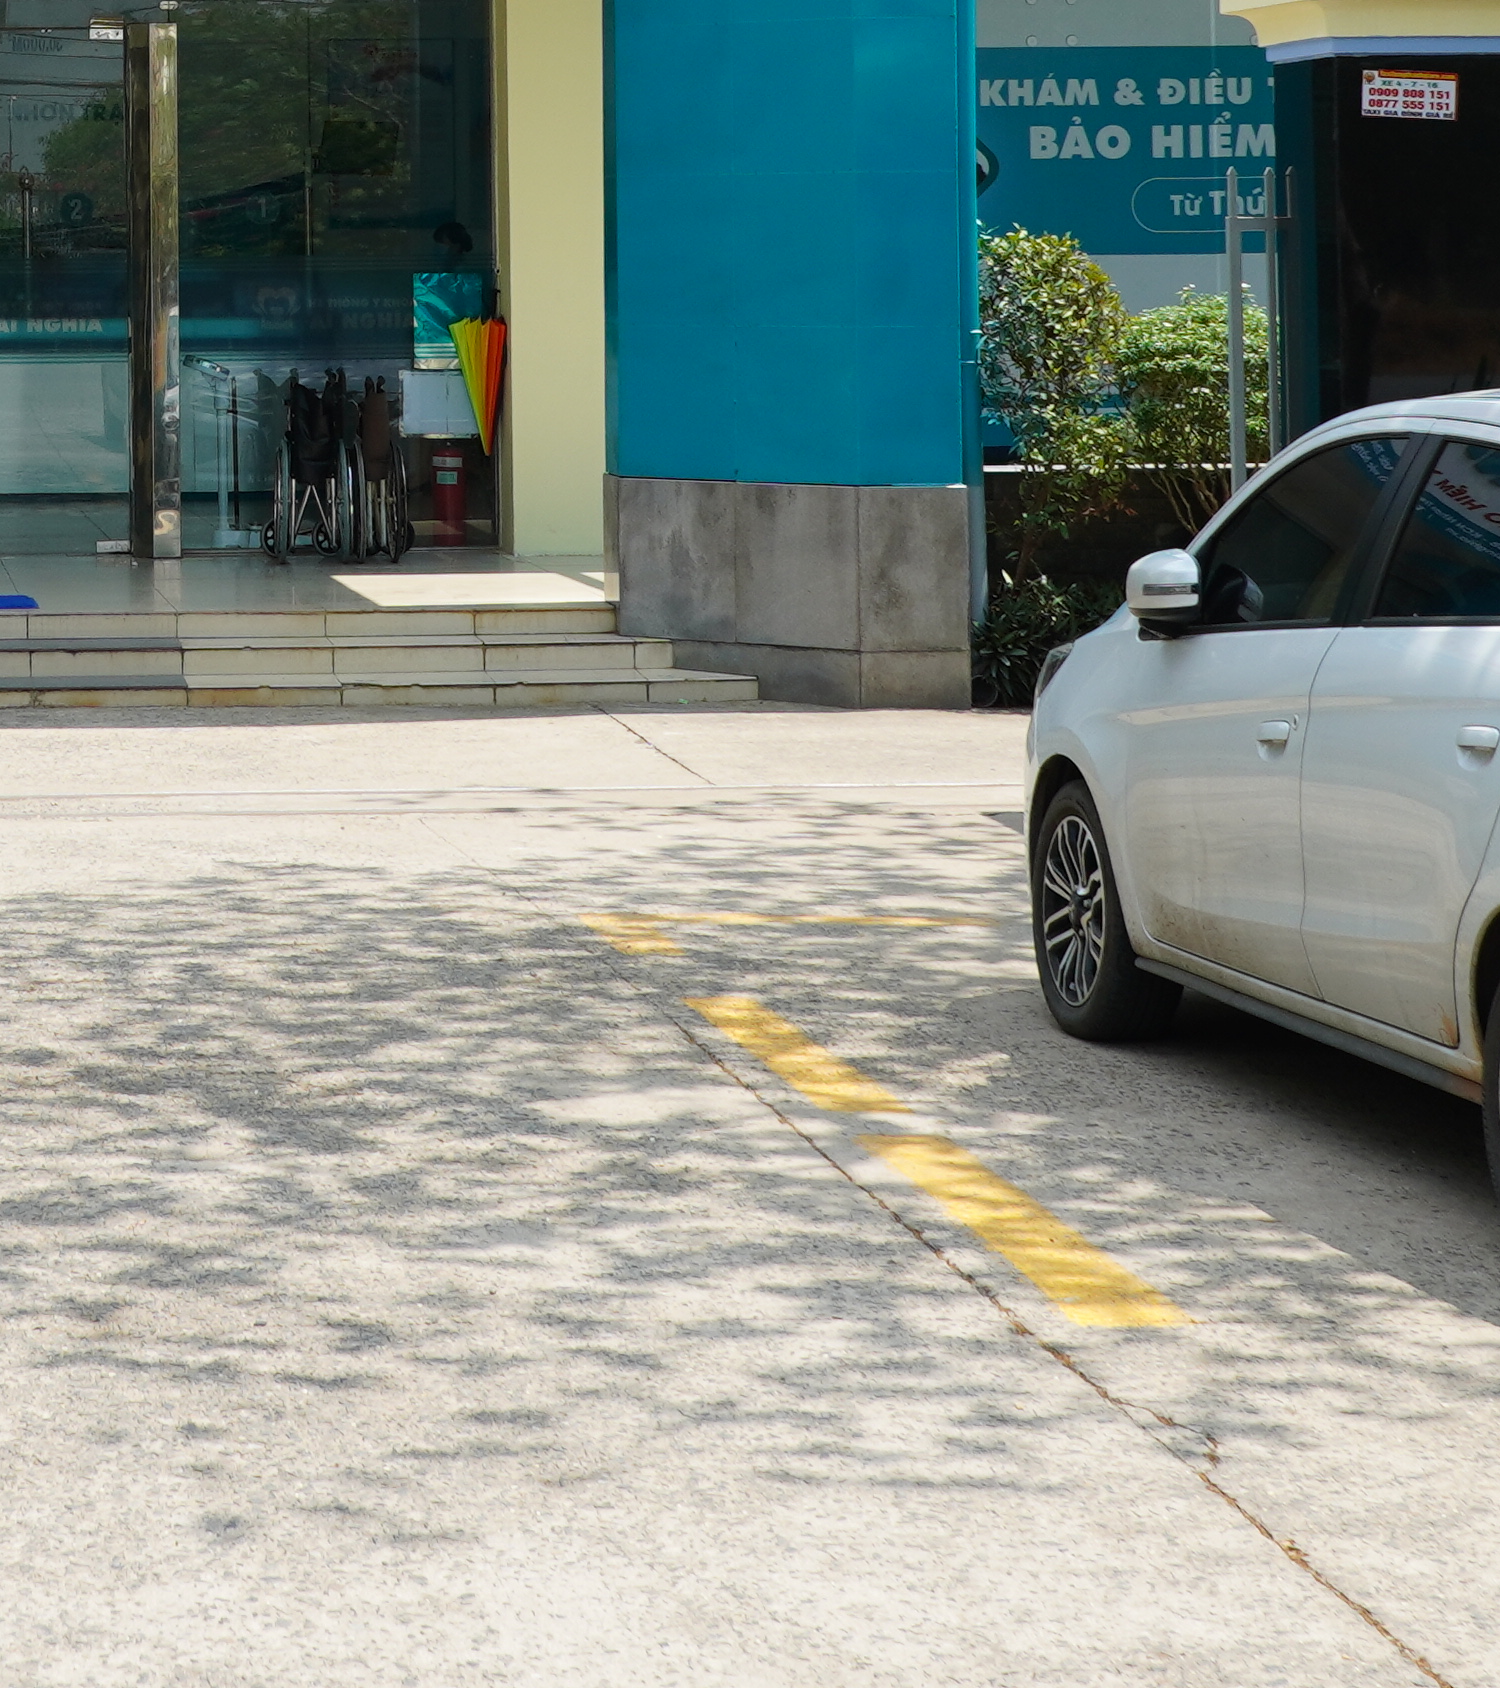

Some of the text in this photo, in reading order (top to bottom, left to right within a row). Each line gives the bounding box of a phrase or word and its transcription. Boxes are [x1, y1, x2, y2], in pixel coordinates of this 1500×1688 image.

[979, 73, 1100, 107] KHÁM
[1113, 78, 1146, 106] &
[1157, 68, 1252, 105] ĐIỀU
[1368, 88, 1399, 97] 0909
[1429, 91, 1450, 100] 151
[1368, 99, 1450, 111] 0877 555 151
[1029, 112, 1276, 160] BẢO HIỂM
[70, 198, 82, 220] 2
[1170, 192, 1203, 217] Từ
